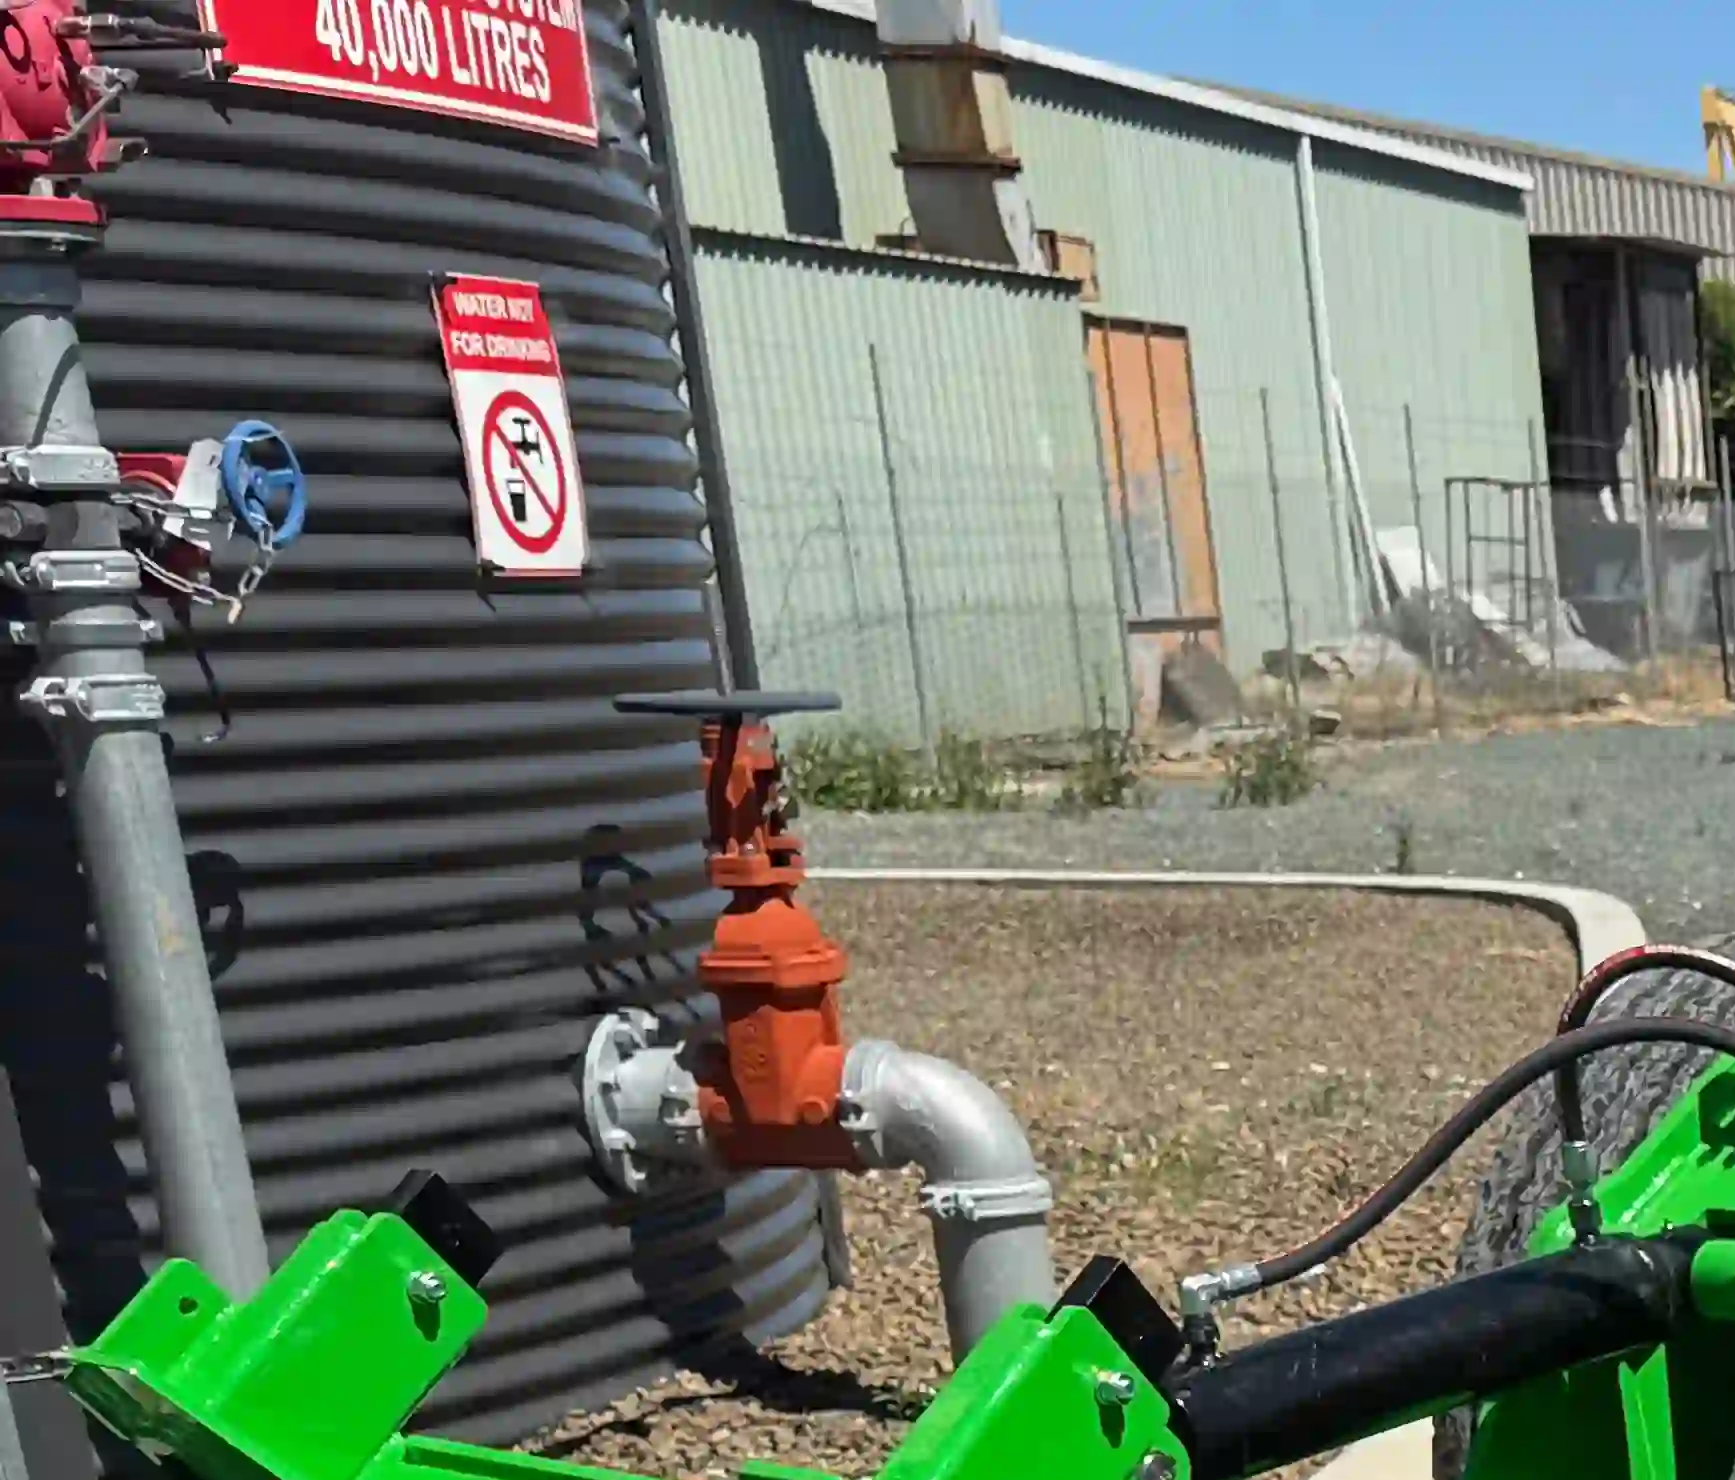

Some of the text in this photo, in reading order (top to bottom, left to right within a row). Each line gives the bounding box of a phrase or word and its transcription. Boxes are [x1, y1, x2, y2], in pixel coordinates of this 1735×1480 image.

[316, 0, 550, 103] 40,000 LITRES
[452, 291, 509, 319] WATER
[450, 330, 486, 357] FOR
